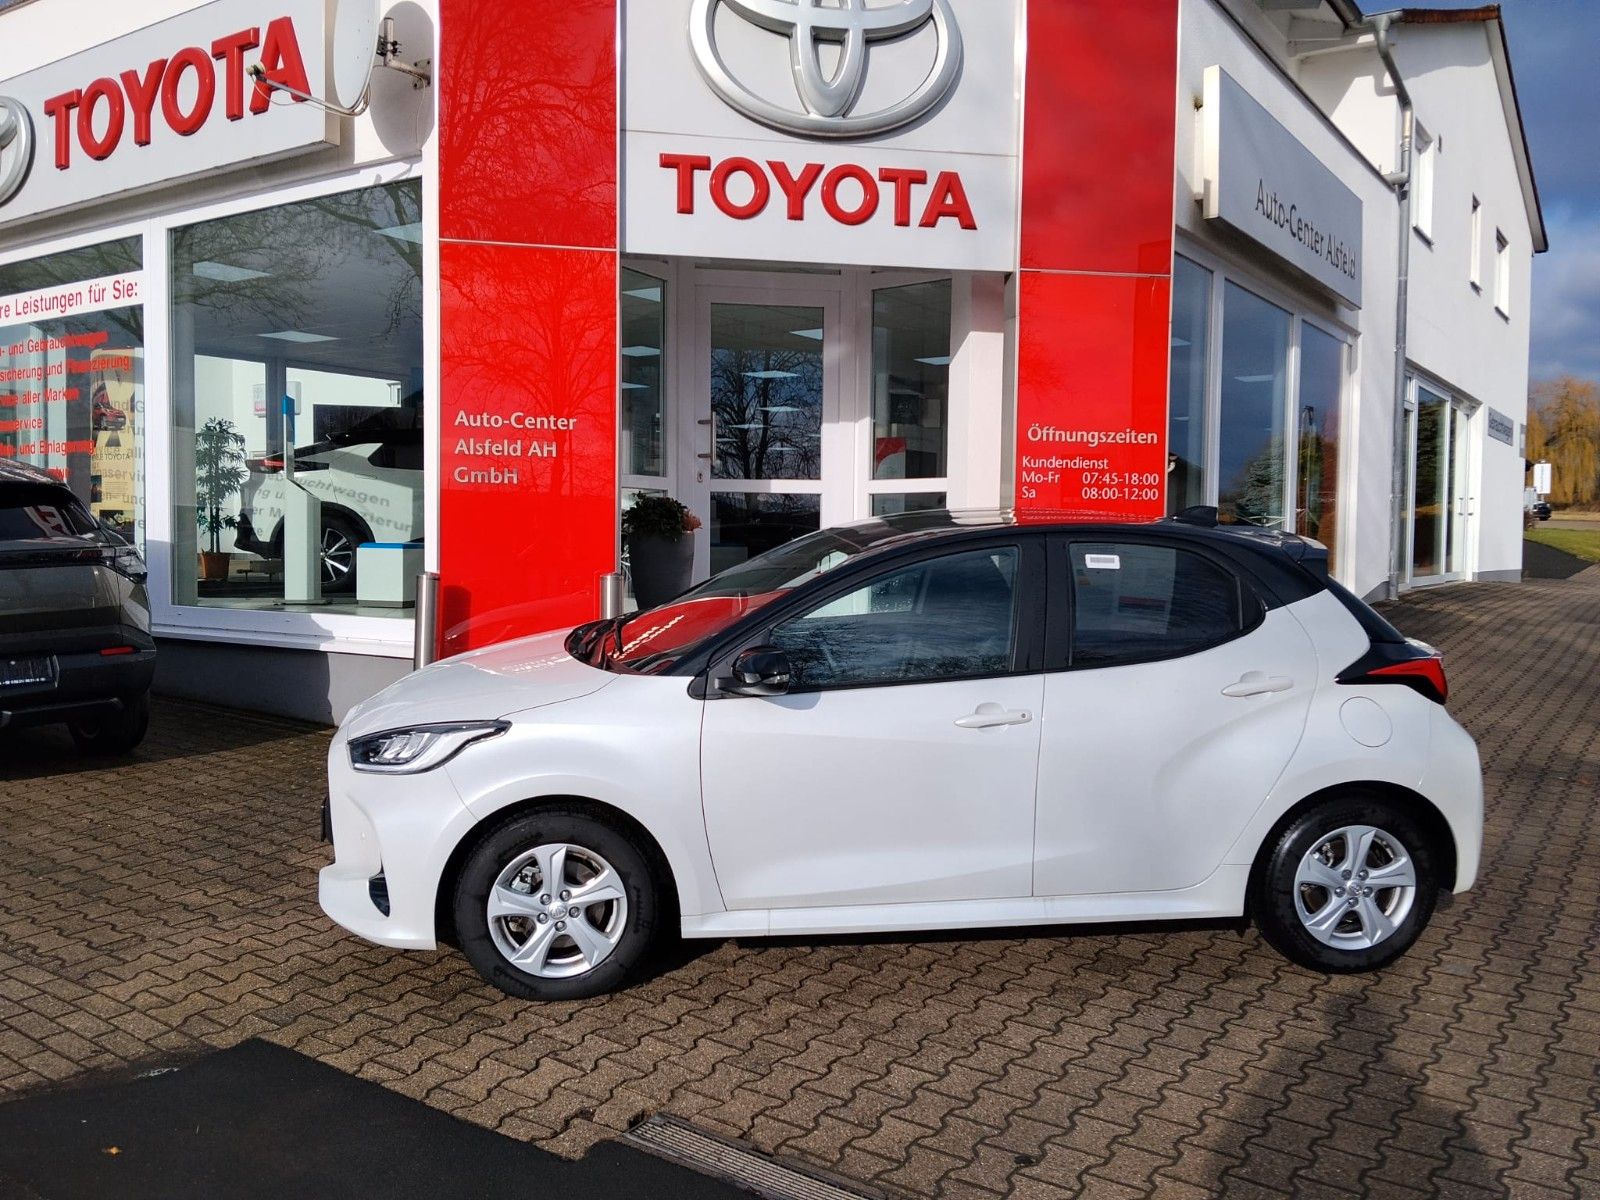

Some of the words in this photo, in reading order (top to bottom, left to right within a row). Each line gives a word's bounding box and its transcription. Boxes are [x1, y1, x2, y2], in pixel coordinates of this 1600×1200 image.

[44, 16, 312, 171] TOYOTA
[659, 153, 977, 230] TOYOTA
[1255, 178, 1325, 257] Auto-Center
[1326, 234, 1356, 280] Alsfeld
[15, 291, 82, 314] Leistungen
[88, 283, 106, 303] für
[112, 279, 138, 300] Sie:
[8, 339, 24, 356] und
[47, 361, 63, 376] und
[22, 390, 41, 405] aller
[454, 410, 577, 430] Auto-Center
[1027, 423, 1158, 447] Öffnungszeiten
[20, 440, 36, 455] und
[454, 437, 522, 457] Alsfeld
[528, 440, 557, 457] AH
[1022, 455, 1109, 470] Kundendienst
[454, 466, 518, 485] GmbH
[1022, 471, 1060, 483] Mo-Fr
[1082, 472, 1159, 485] 07:45-18:00
[1022, 486, 1036, 498] Sa
[1081, 487, 1159, 501] 08:00-12:00
